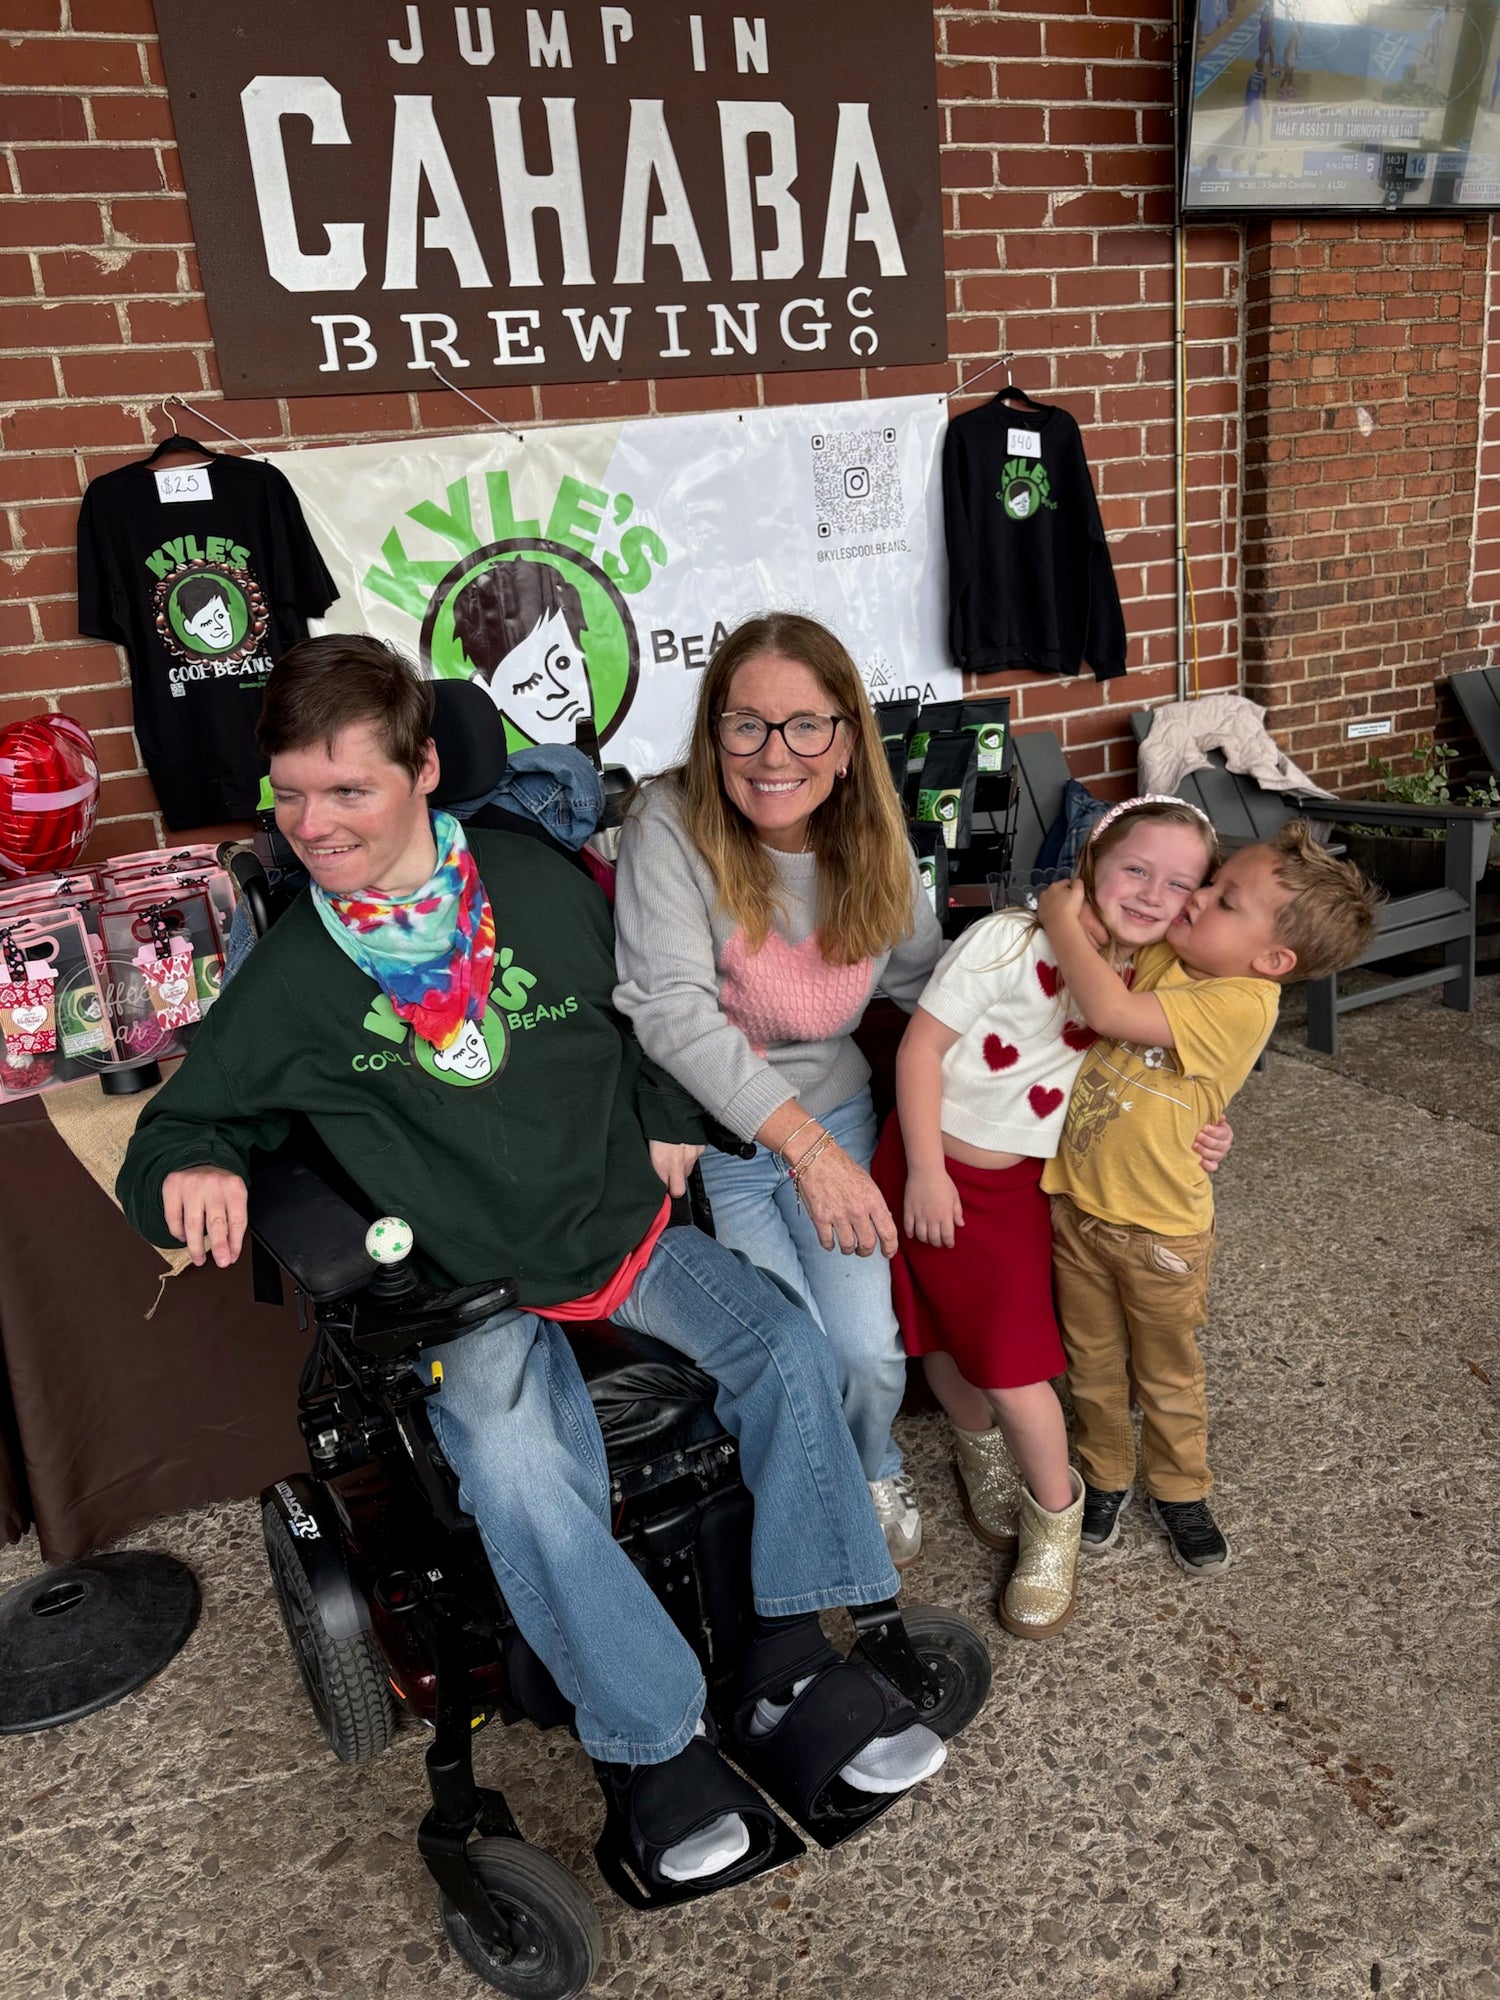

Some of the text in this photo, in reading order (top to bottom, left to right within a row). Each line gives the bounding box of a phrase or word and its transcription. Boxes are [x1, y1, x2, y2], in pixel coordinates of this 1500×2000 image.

[387, 5, 770, 74] JUMP IN
[1275, 122, 1297, 137] HALF
[1299, 122, 1330, 137] ASSIST
[1346, 123, 1388, 137] TURNOVER
[1366, 157, 1376, 173] 5
[1410, 156, 1426, 174] 16
[240, 75, 908, 293] CAHABA
[1200, 181, 1231, 193] ESPN
[310, 298, 832, 373] BREWING
[160, 475, 200, 495] $25
[145, 534, 251, 580] KYLE'S
[362, 470, 668, 623] KYLE'S
[650, 619, 729, 670] BEA
[168, 656, 275, 683] COOL BEANS
[917, 791, 928, 821] YLE'S
[507, 996, 579, 1030] BEANS
[351, 1050, 411, 1072] COOL
